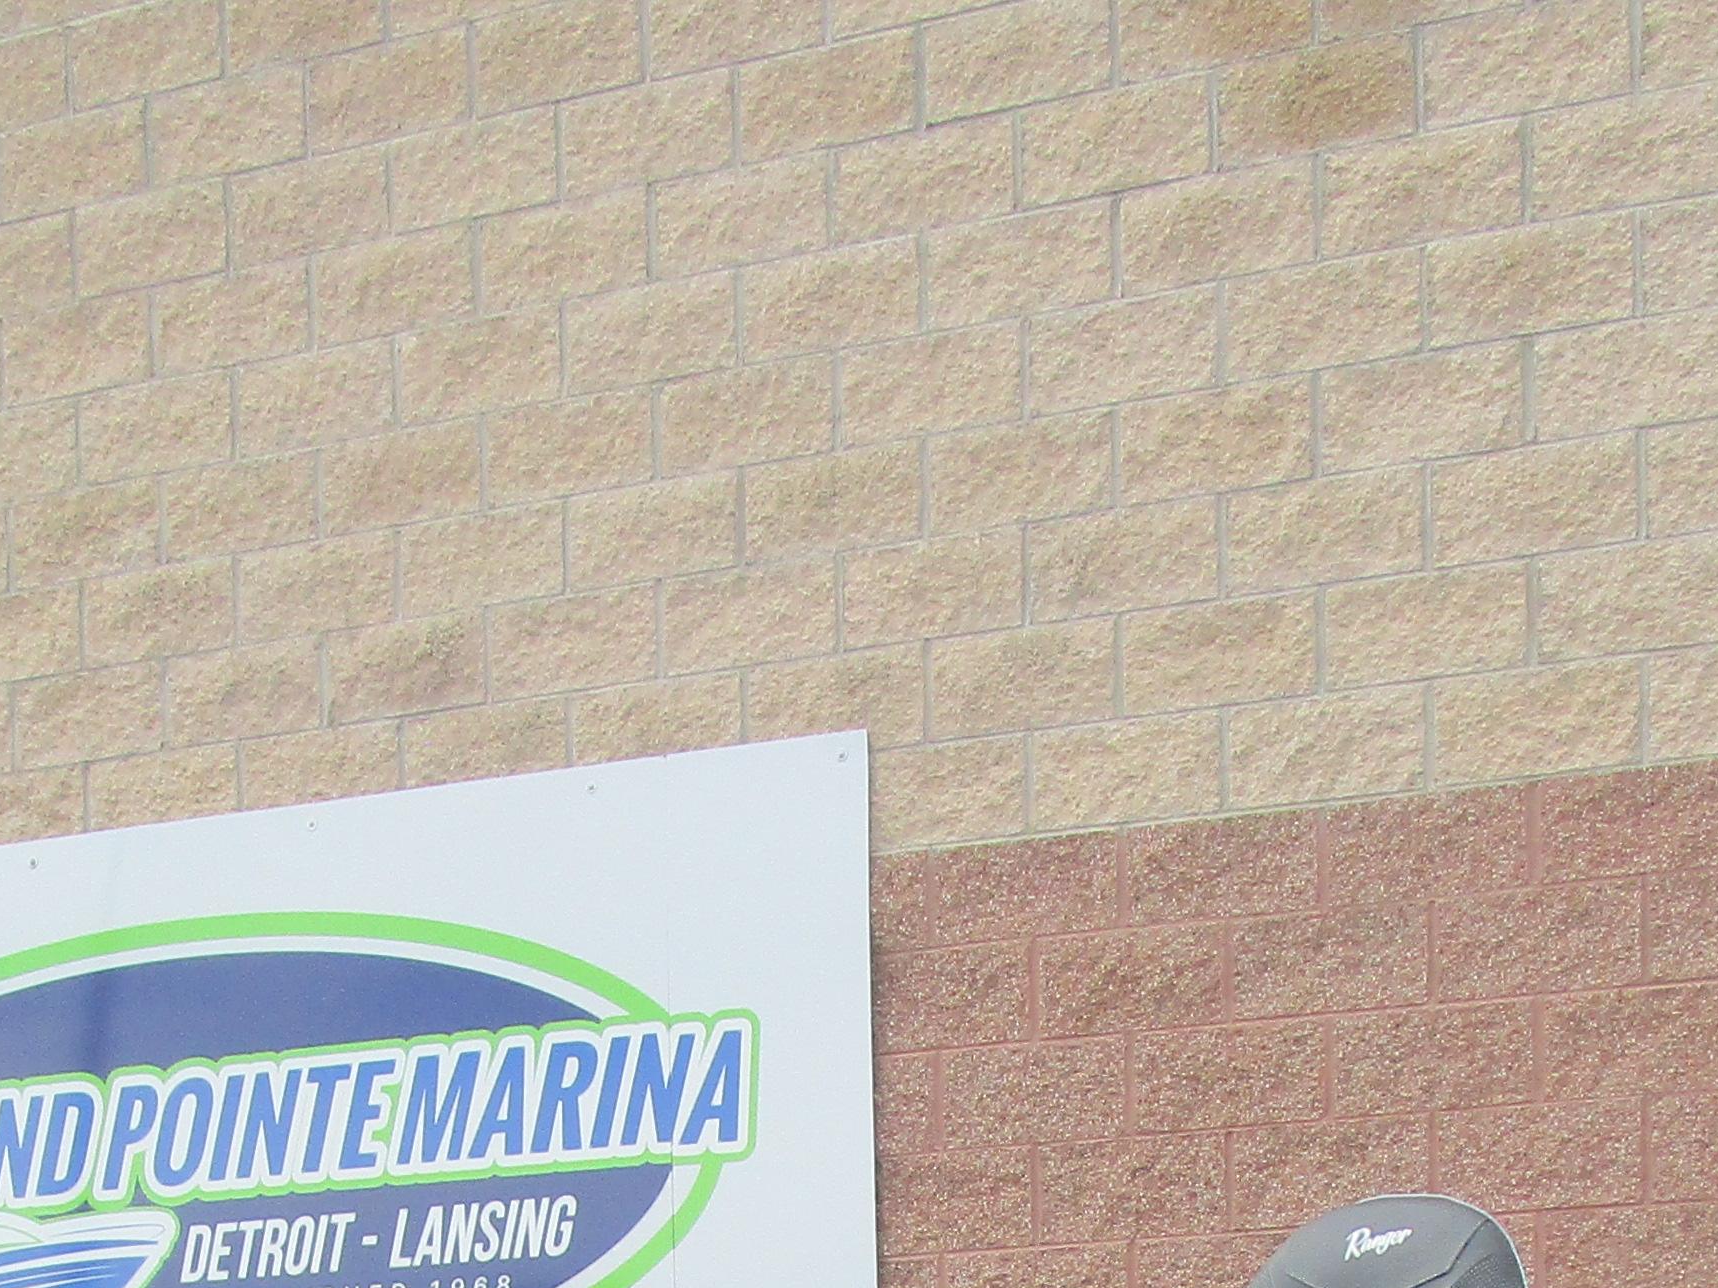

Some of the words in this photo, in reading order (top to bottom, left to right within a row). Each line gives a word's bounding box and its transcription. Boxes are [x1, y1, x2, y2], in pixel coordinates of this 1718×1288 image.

[100, 1057, 397, 1193] POINTE
[395, 1028, 744, 1166] MARINA
[179, 1211, 358, 1284] DETROIT
[388, 1194, 578, 1269] LANSING
[1344, 1226, 1413, 1261] Ranger
